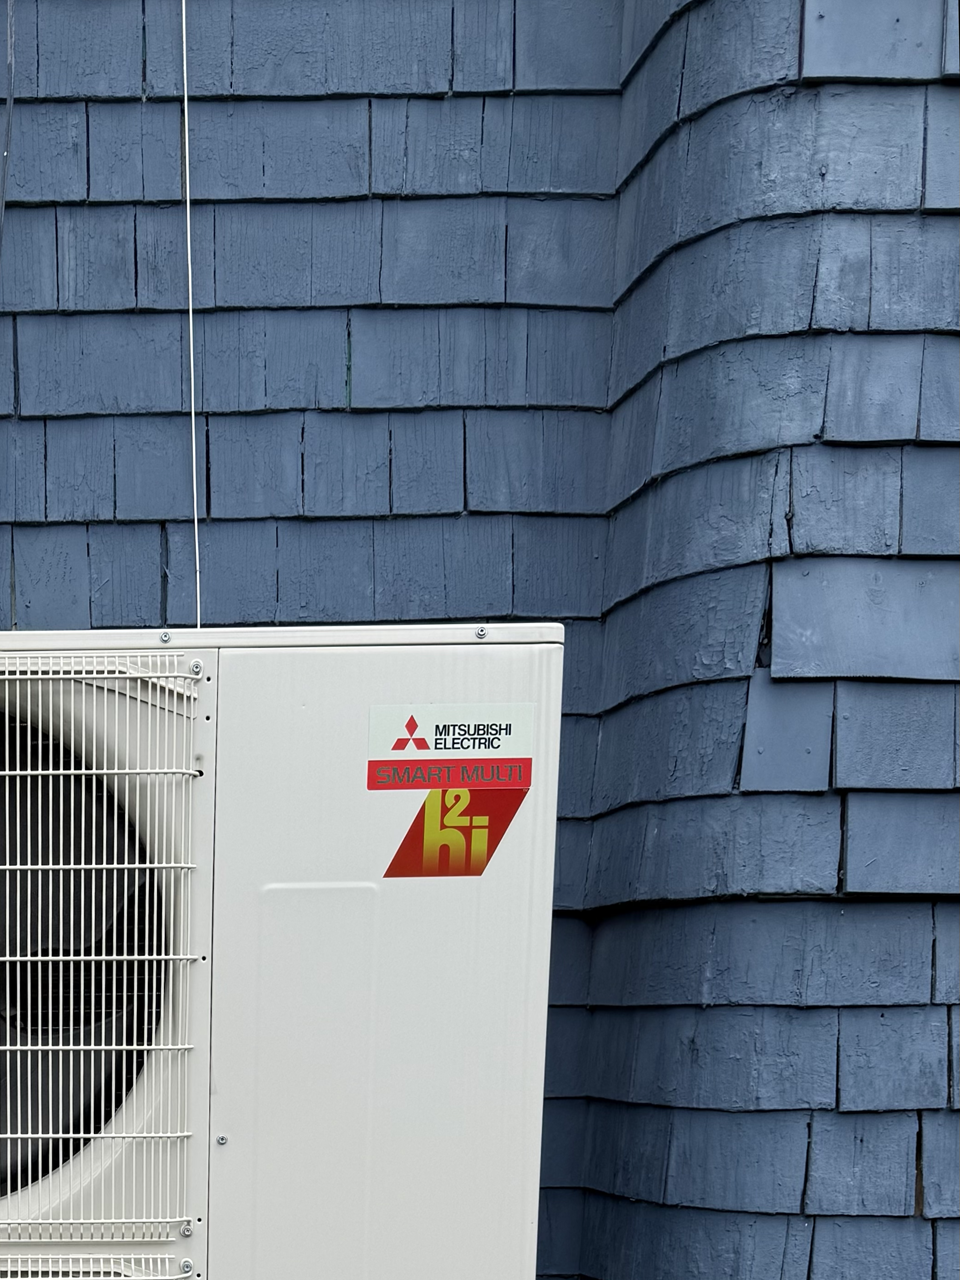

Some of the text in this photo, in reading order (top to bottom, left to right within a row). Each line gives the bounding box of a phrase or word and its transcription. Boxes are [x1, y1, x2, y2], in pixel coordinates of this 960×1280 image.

[434, 723, 512, 737] MITSUBISHI
[434, 737, 501, 751] ELECTRIC
[376, 764, 523, 784] SMART MULTI
